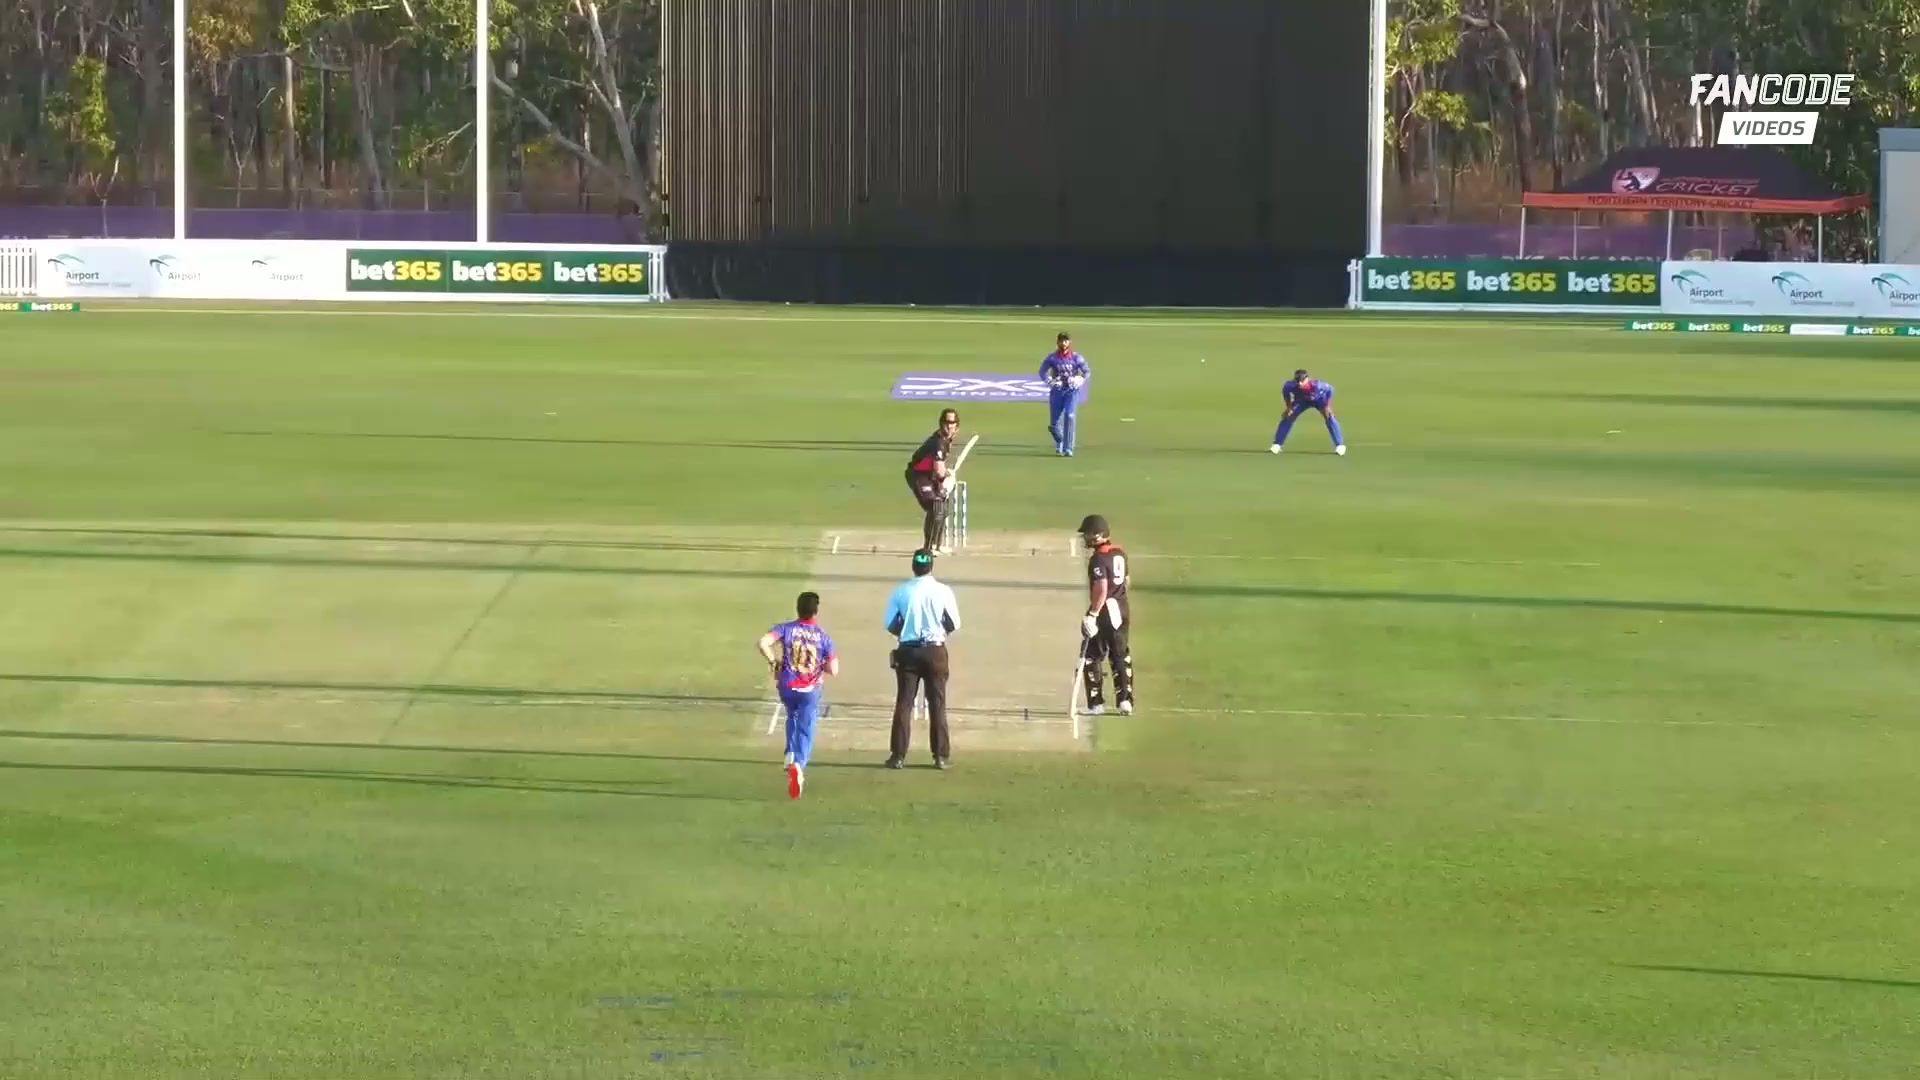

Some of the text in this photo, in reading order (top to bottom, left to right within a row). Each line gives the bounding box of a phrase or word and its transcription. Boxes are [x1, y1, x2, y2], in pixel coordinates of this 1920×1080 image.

[1656, 181, 1759, 195] CRICKET
[350, 259, 442, 282] bet365
[452, 260, 543, 283] bet365
[553, 261, 644, 284] bet365
[65, 271, 100, 282] Airport
[168, 272, 201, 282] Airport
[1367, 269, 1457, 291] bet365
[1466, 270, 1557, 293] bet365
[1567, 271, 1657, 294] bet365
[1689, 287, 1724, 298] Airport
[1790, 288, 1823, 299] Airport
[31, 302, 73, 311] bet365
[1631, 321, 1676, 331] bet365
[1688, 322, 1731, 332] bet365
[1743, 323, 1785, 333] bet365
[1853, 326, 1896, 335] bet365
[1112, 555, 1126, 586] 9
